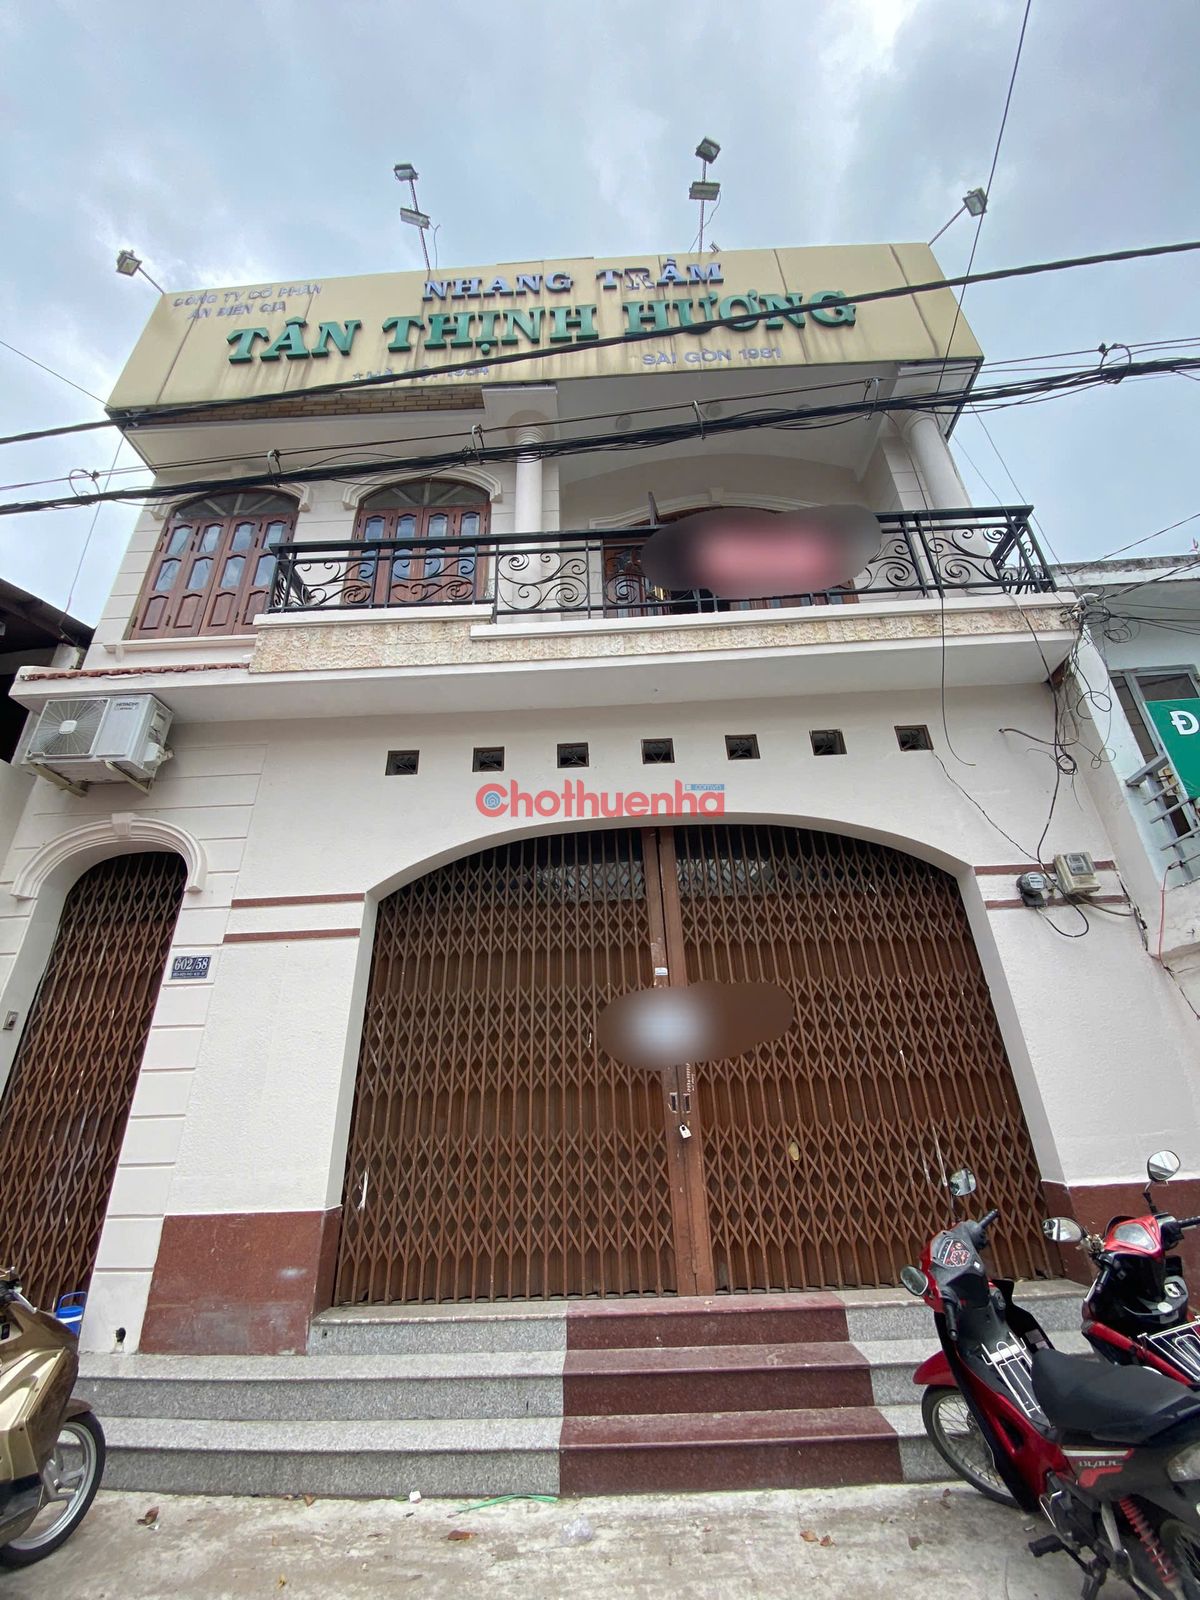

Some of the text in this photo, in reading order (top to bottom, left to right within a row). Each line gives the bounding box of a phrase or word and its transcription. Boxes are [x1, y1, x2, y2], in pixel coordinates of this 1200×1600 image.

[422, 271, 574, 301] NHANG
[226, 288, 857, 365] TÂN THỊNH HƯƠNG
[641, 351, 677, 366] SÀI
[684, 348, 733, 363] GÒN
[174, 957, 209, 970] 602/58
